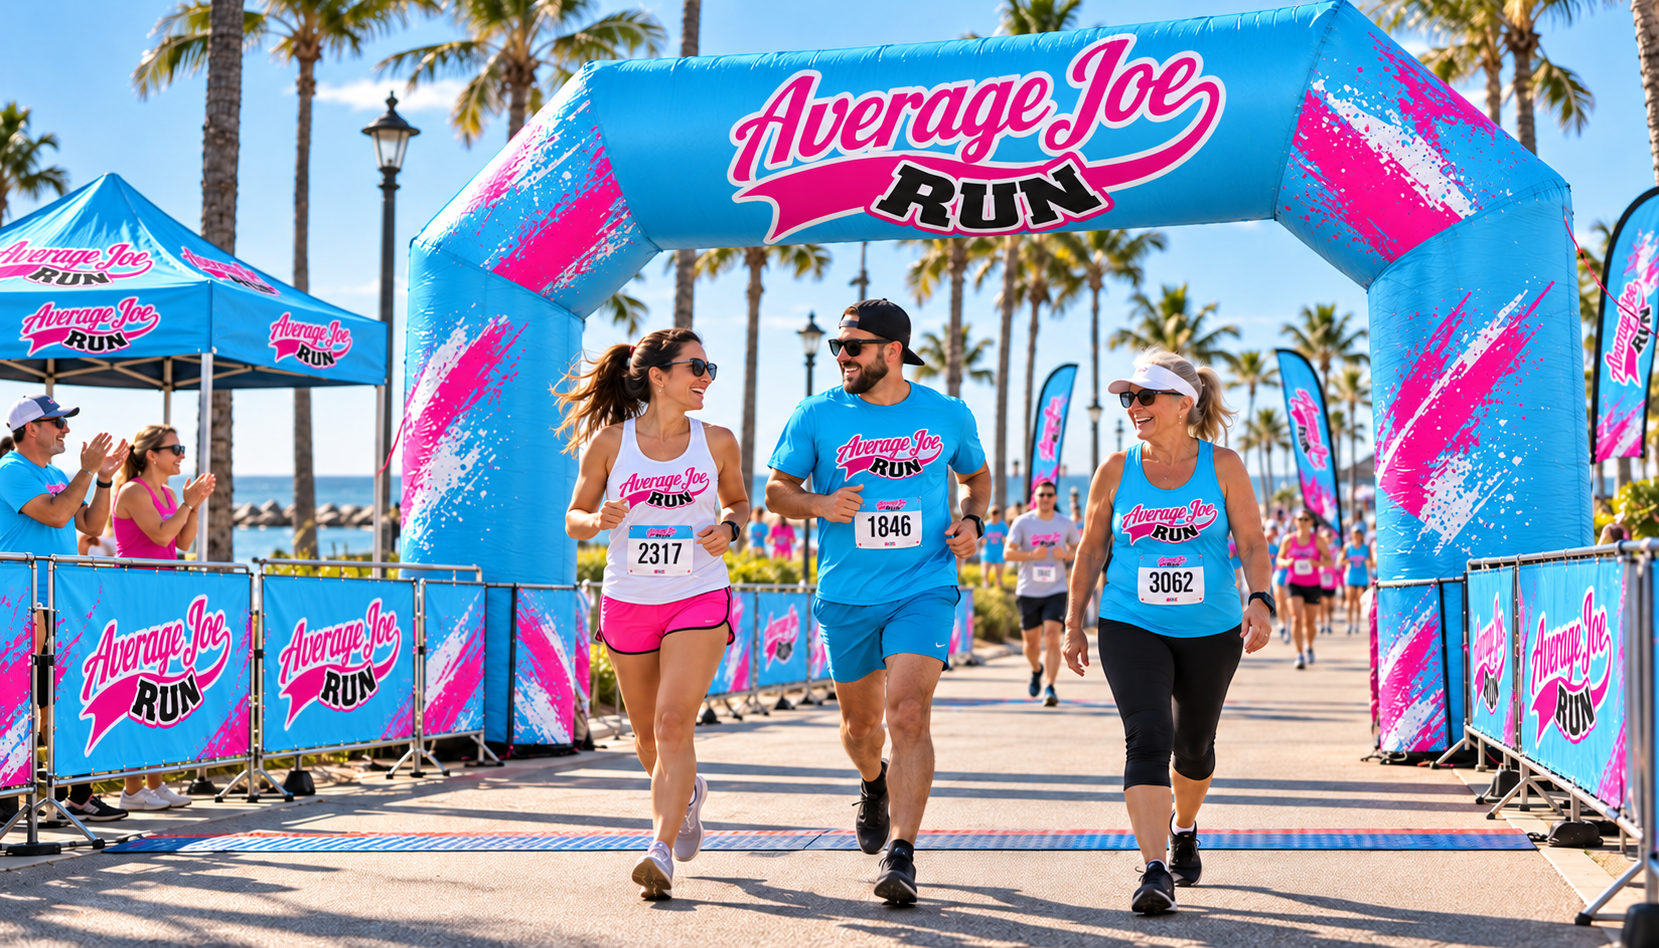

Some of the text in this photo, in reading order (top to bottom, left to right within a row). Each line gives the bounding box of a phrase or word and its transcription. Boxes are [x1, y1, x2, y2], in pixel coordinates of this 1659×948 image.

[734, 38, 1198, 182] Average Joe
[876, 163, 1103, 230] RUN
[0, 240, 149, 269] Average Joe
[28, 266, 111, 286] RUN
[22, 297, 154, 334] Average Joe
[269, 312, 350, 347] Average Joe
[63, 329, 128, 351] RUN
[296, 343, 335, 366] RUN
[836, 429, 941, 463] Average Joe
[619, 467, 707, 497] Average Joe
[868, 457, 922, 477] RUN
[647, 490, 693, 507] RUN
[1122, 499, 1214, 528] Average Joe
[867, 514, 912, 538] 1846
[1151, 524, 1199, 542] RUN
[637, 542, 683, 565] 2317
[1148, 571, 1194, 594] 3062
[82, 598, 224, 701] Average Joe
[280, 601, 395, 685] Average Joe
[1531, 617, 1582, 696] Average
[1581, 591, 1606, 676] Joe
[131, 674, 201, 723] RUN
[320, 665, 377, 707] RUN
[1555, 683, 1595, 736] RUN
